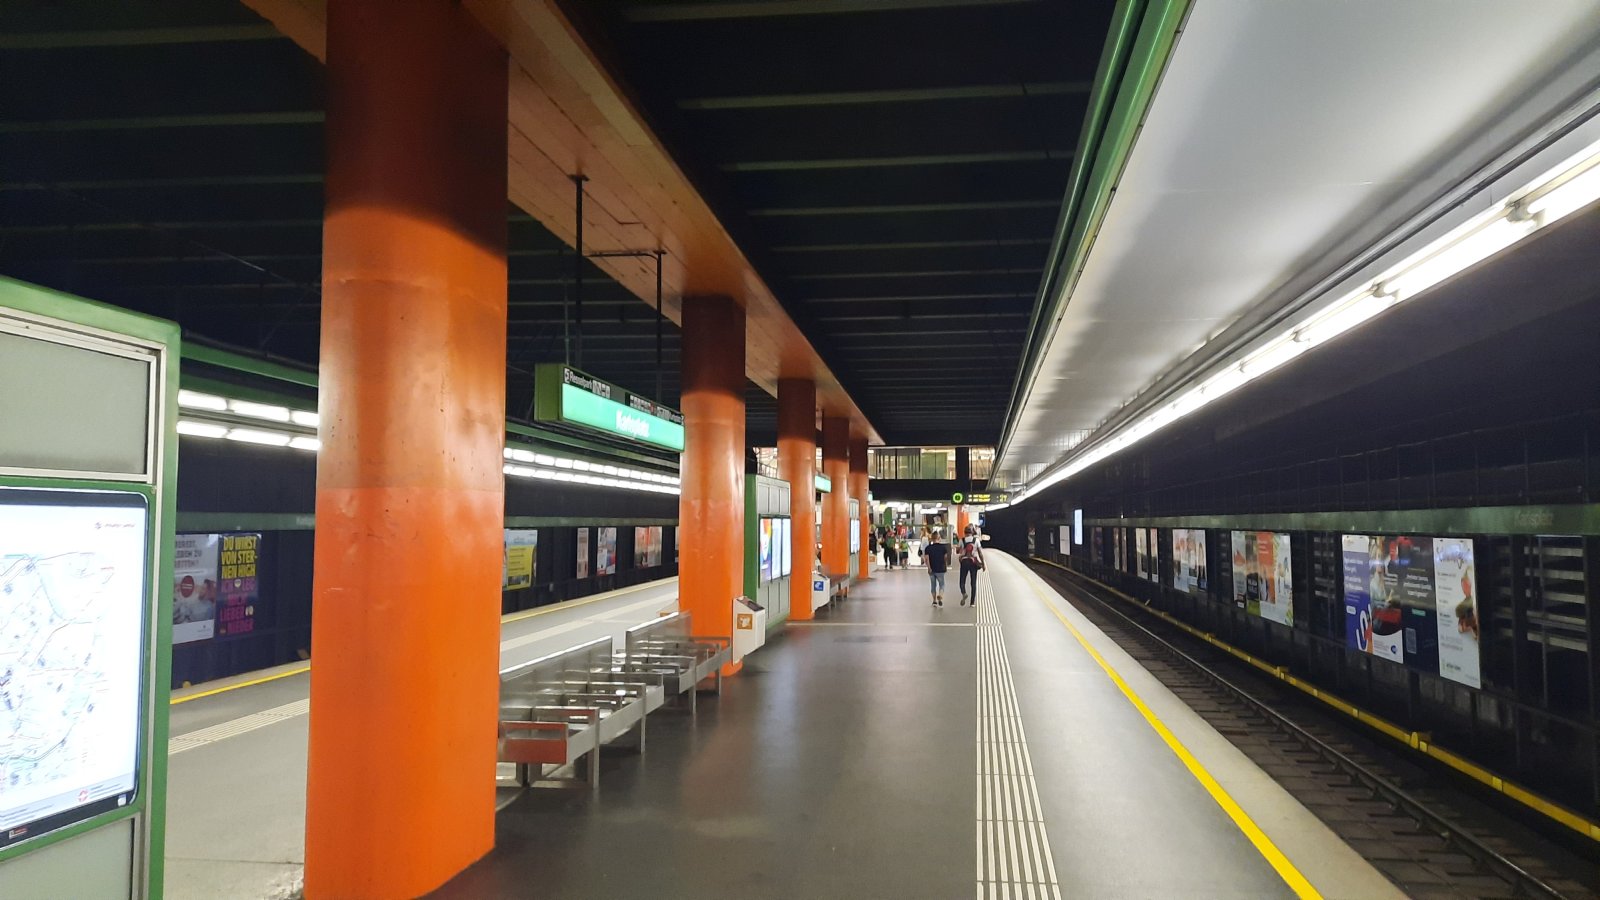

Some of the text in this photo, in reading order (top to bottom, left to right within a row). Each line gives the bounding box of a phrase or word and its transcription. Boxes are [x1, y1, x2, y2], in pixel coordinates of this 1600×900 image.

[223, 535, 257, 550] DU WIRST
[221, 550, 237, 564] VON
[221, 563, 256, 579] NEN HIGH
